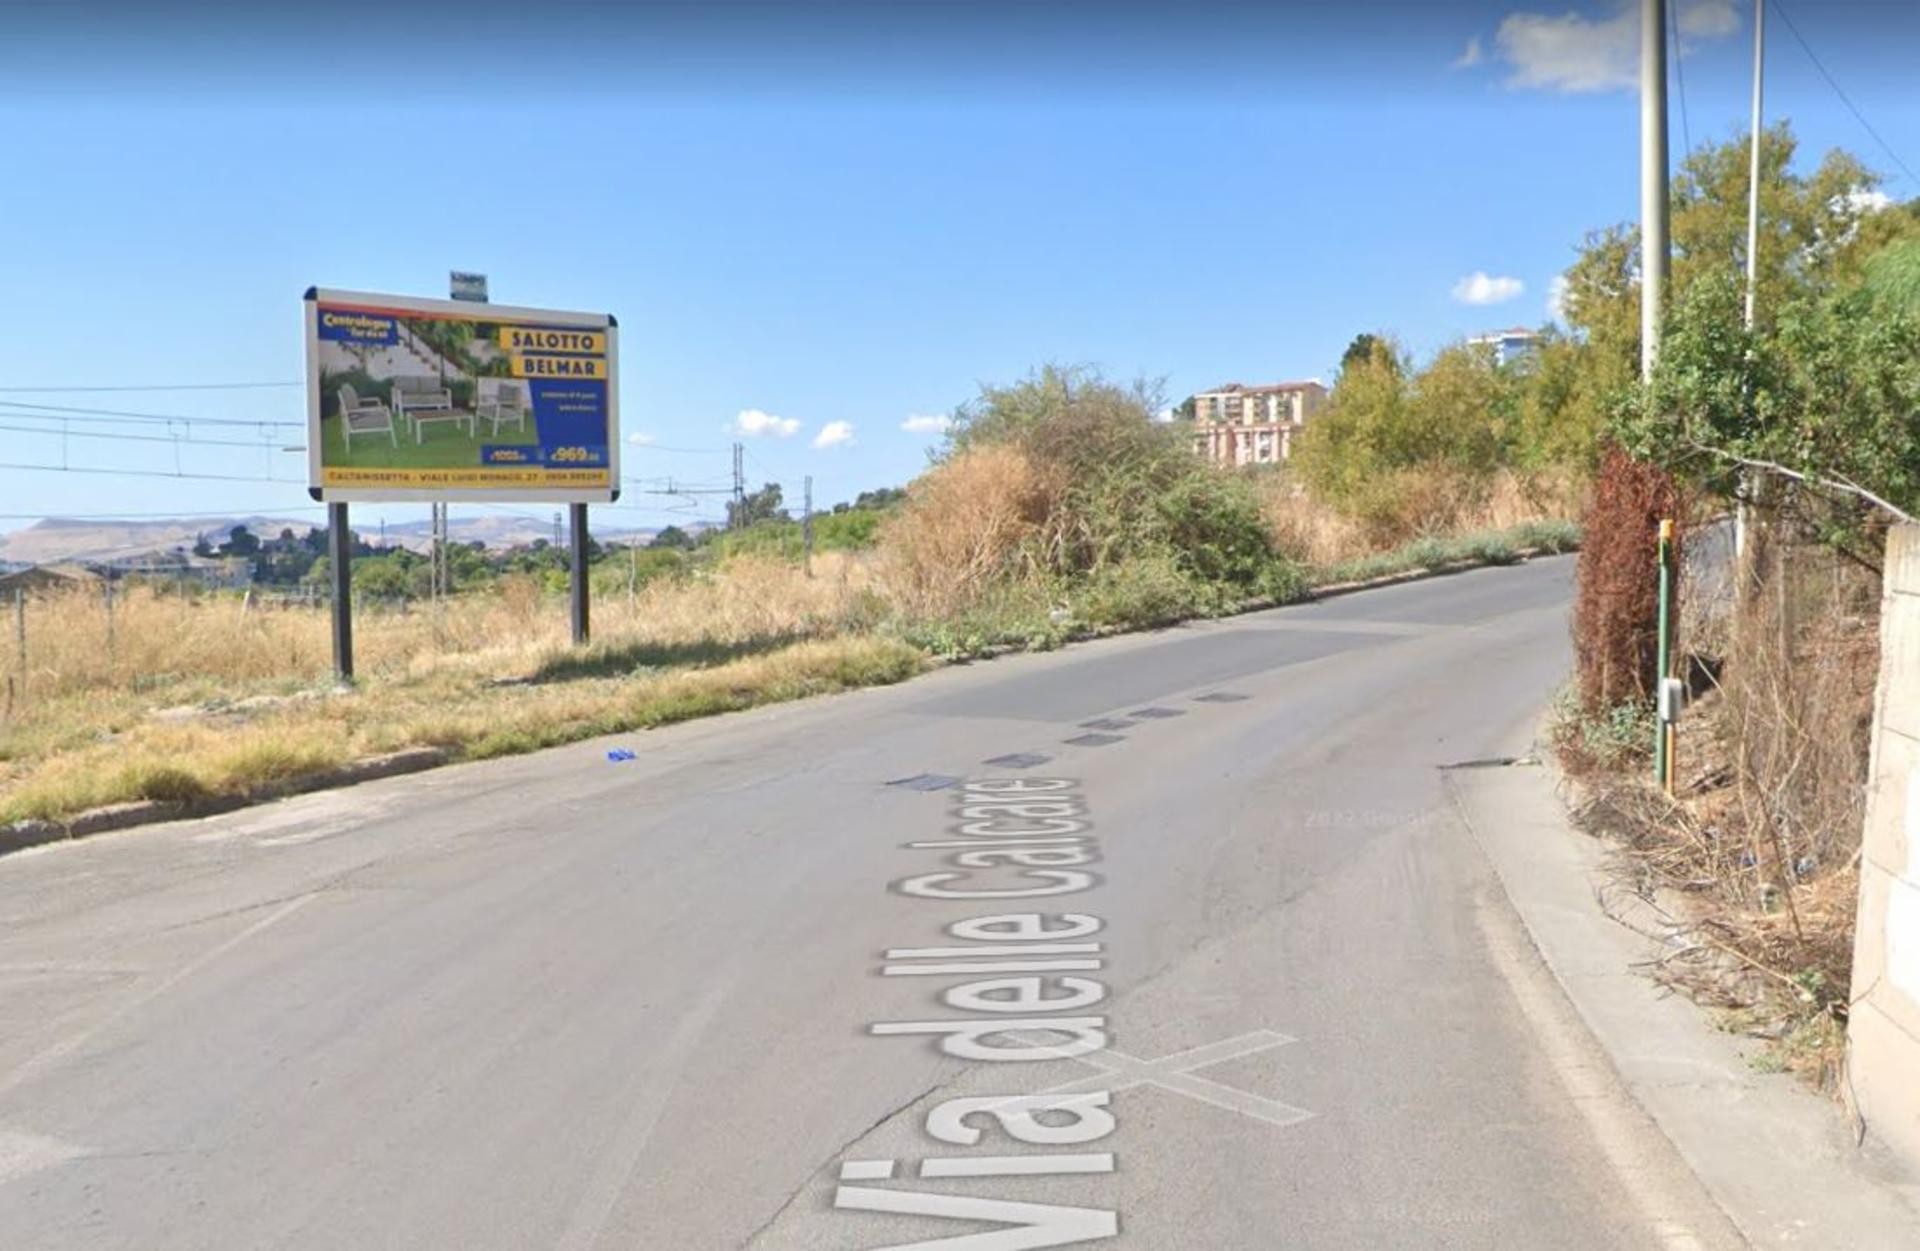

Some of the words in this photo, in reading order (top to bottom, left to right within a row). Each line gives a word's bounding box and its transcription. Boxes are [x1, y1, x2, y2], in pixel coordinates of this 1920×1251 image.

[512, 331, 595, 350] SALOTTO
[524, 358, 595, 376] BELMAR
[419, 473, 449, 482] VIALE
